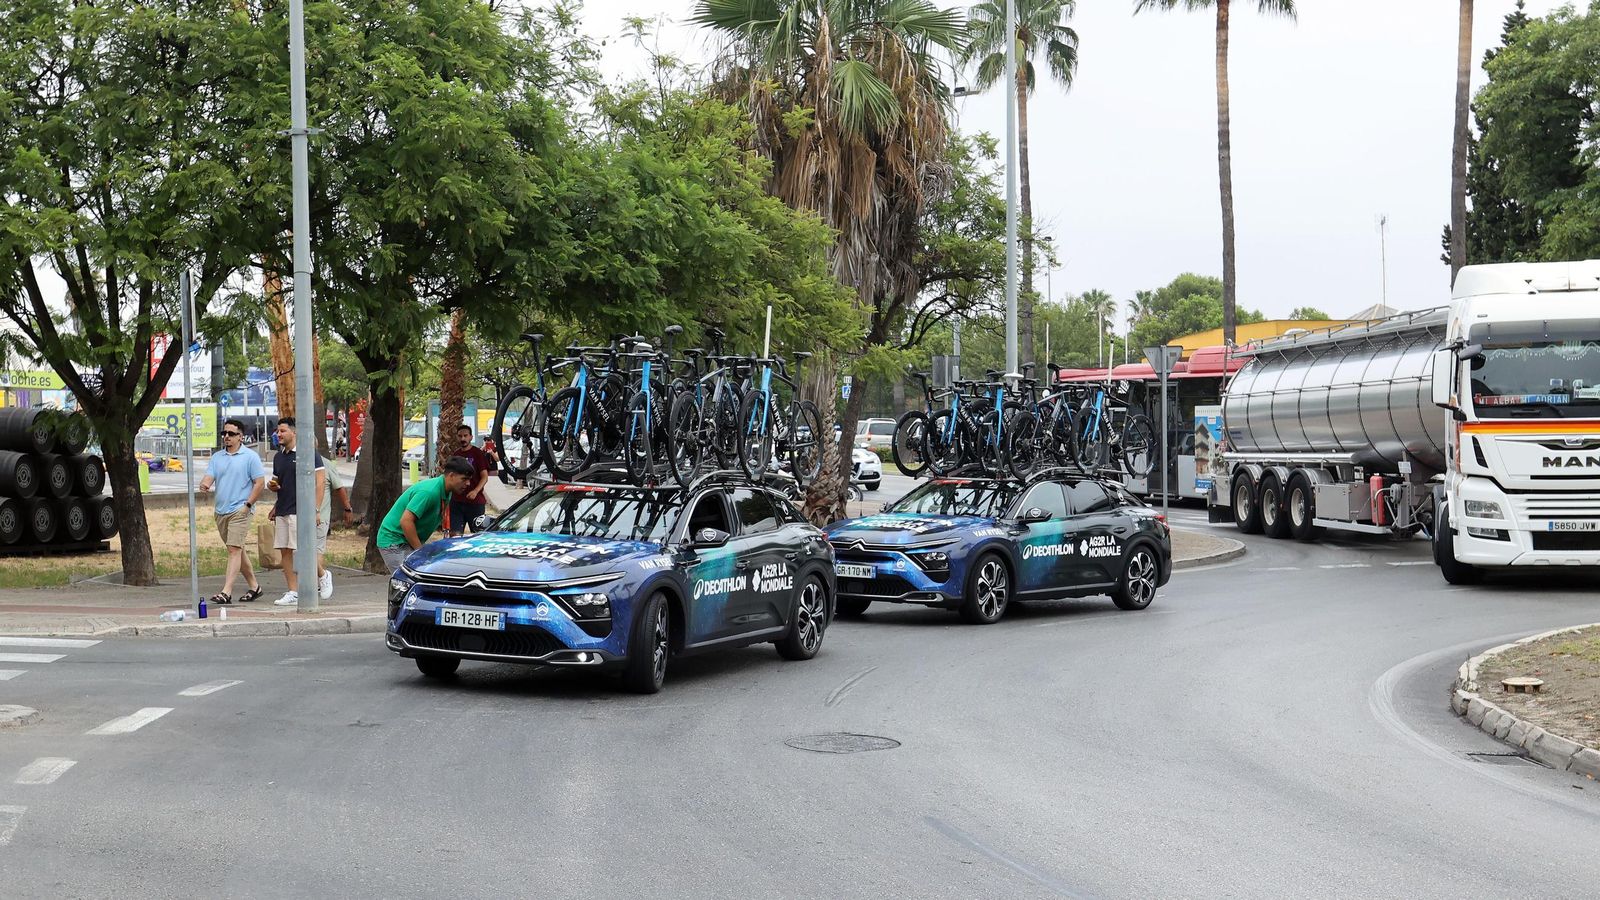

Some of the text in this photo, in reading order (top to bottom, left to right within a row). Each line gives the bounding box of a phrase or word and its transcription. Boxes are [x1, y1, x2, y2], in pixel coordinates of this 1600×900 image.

[589, 387, 610, 423] VAN RYSEL
[1543, 457, 1600, 468] MAN
[1554, 522, 1577, 530] 5850
[1089, 536, 1116, 546] AG2R LA
[1033, 543, 1074, 558] DECATHLON
[1088, 545, 1121, 558] MONDIALE
[638, 559, 654, 570] VAN
[761, 562, 788, 579] AG2R LA
[704, 575, 747, 596] DECATHLON
[760, 576, 793, 594] MONDIALE
